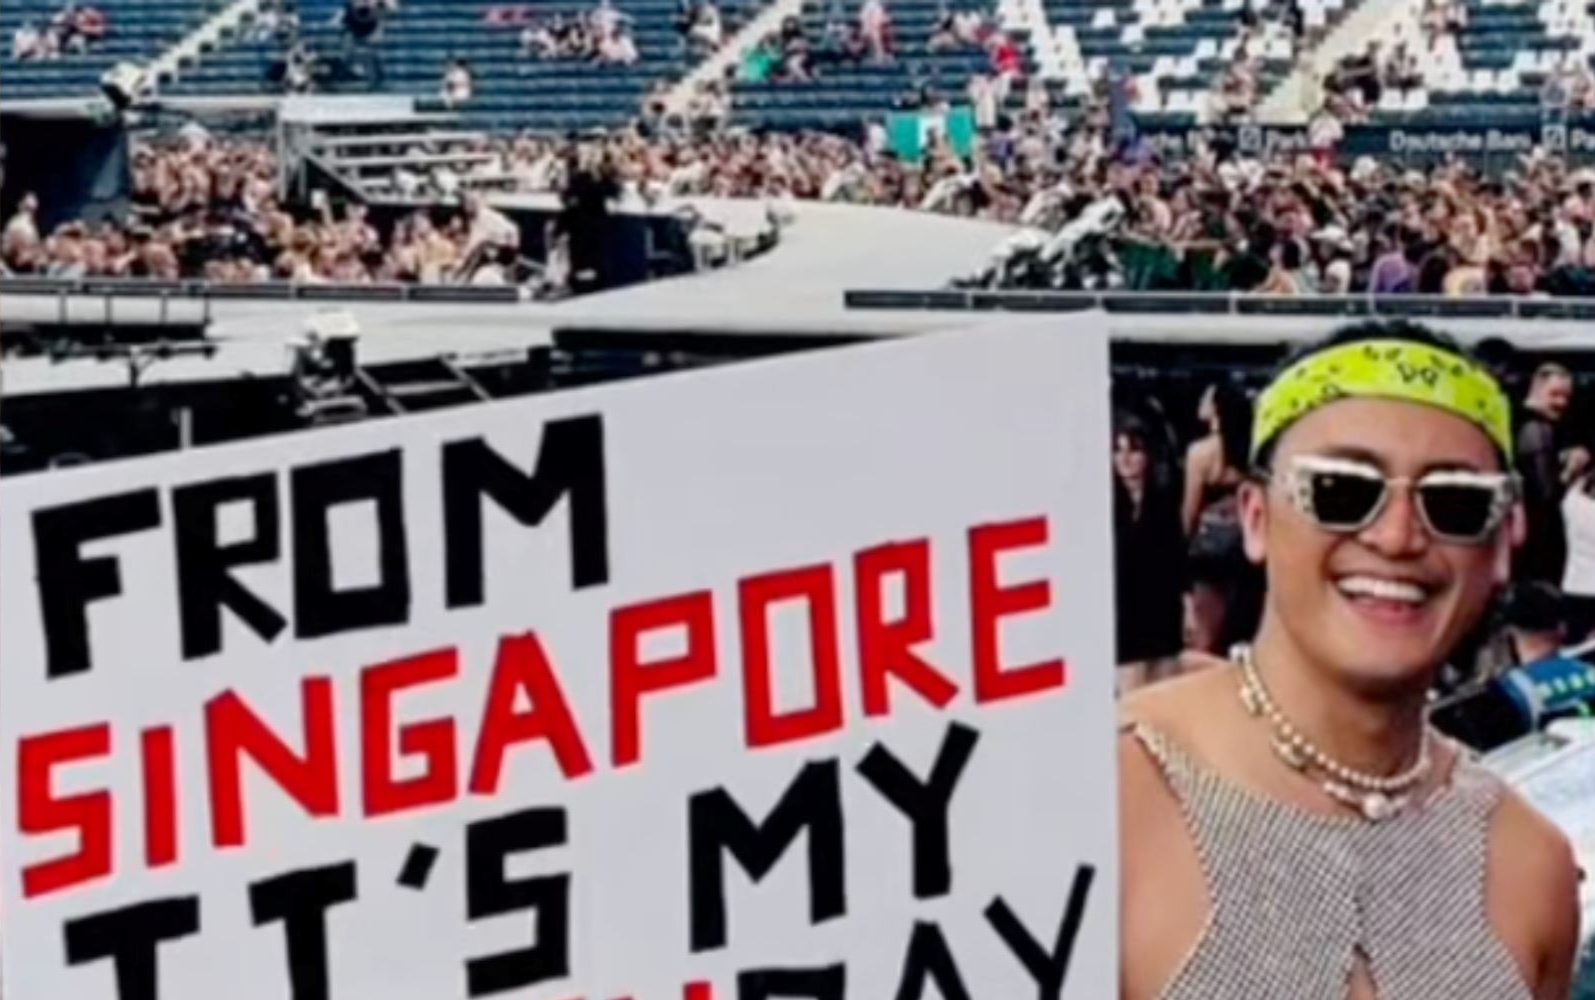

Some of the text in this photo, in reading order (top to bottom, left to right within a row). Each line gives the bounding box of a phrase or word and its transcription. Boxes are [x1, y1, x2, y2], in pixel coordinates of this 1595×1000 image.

[31, 413, 609, 680] FROM
[18, 516, 1066, 898] SINGAPORE
[687, 720, 981, 954] MY
